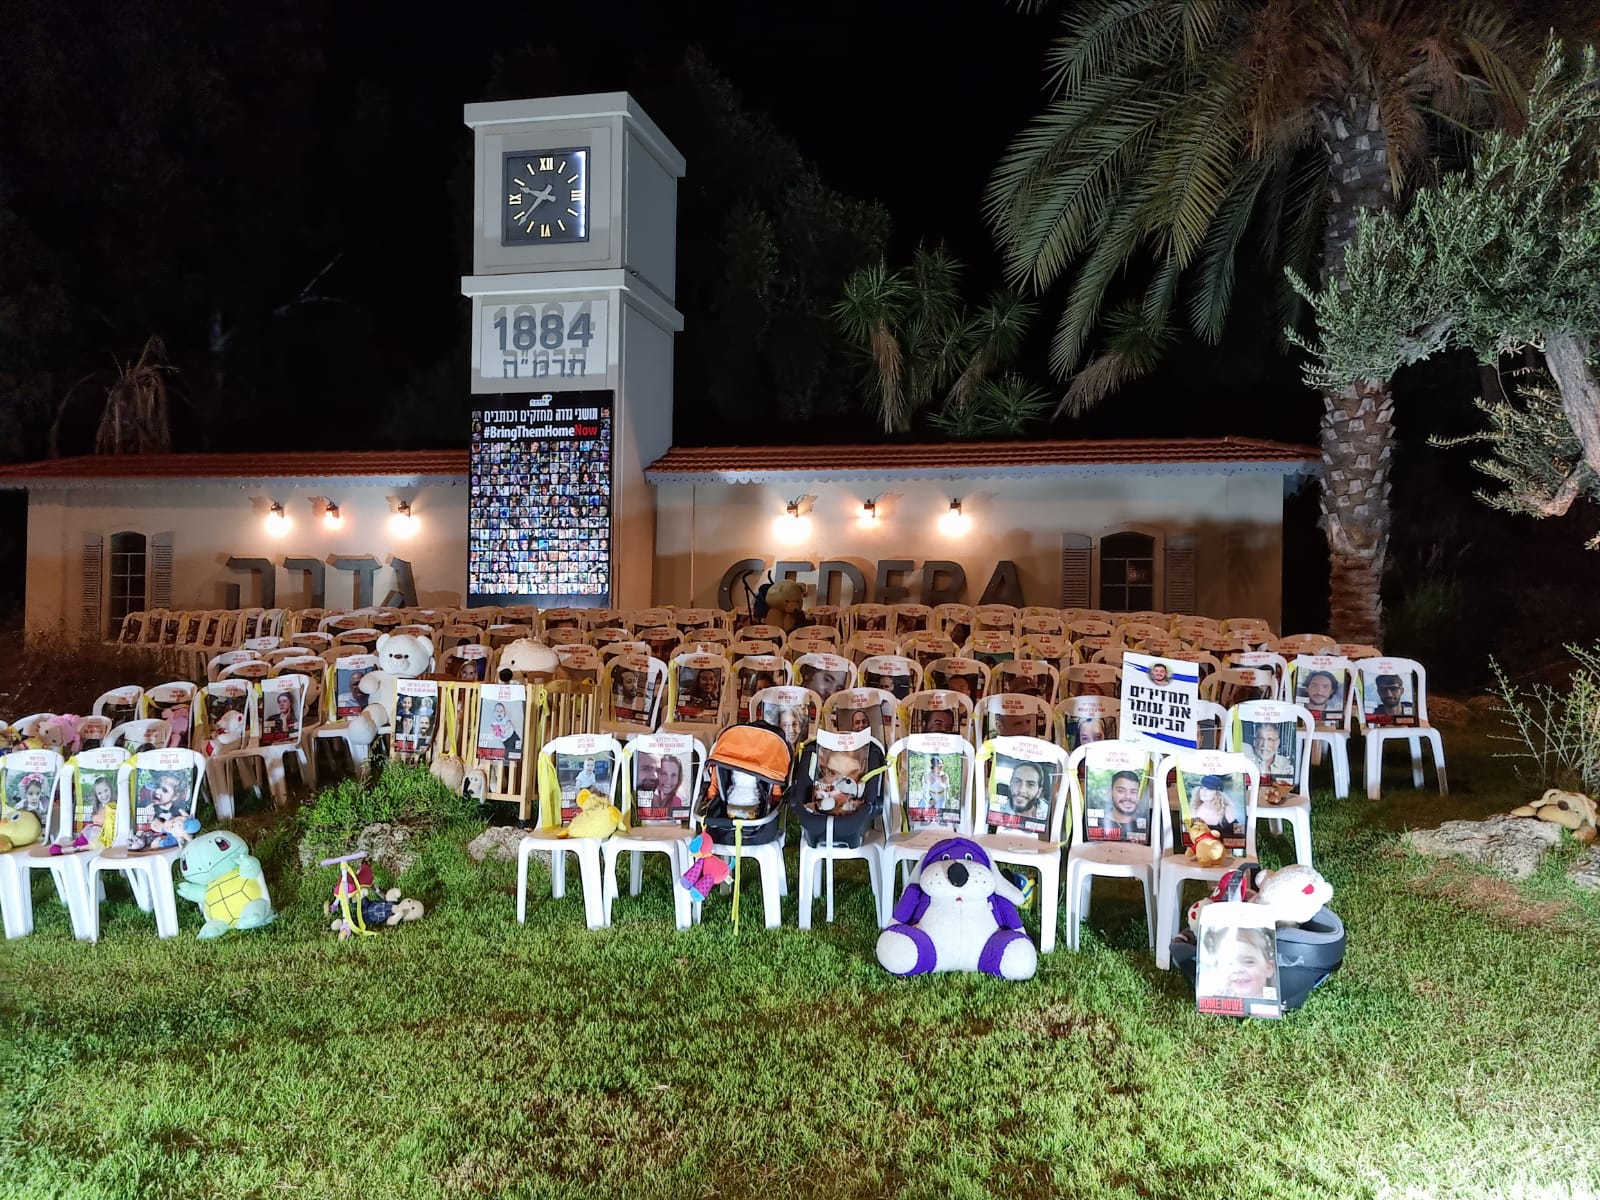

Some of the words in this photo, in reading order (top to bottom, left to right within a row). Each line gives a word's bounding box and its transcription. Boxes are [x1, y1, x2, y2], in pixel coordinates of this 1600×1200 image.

[539, 157, 554, 171] XII
[493, 312, 594, 351] 1884
[520, 408, 553, 424] מחזקים
[555, 408, 574, 421] גדרה
[575, 407, 599, 421] תושבי
[483, 423, 598, 441] #BringThemHomeNow
[225, 555, 419, 609] גדרה
[1130, 685, 1190, 705] מחזירים
[1127, 698, 1164, 714] עומר
[1168, 705, 1192, 719] את
[1132, 712, 1186, 732] הביתה!
[1199, 996, 1221, 1008] HOME
[1221, 998, 1244, 1011] NOW!
